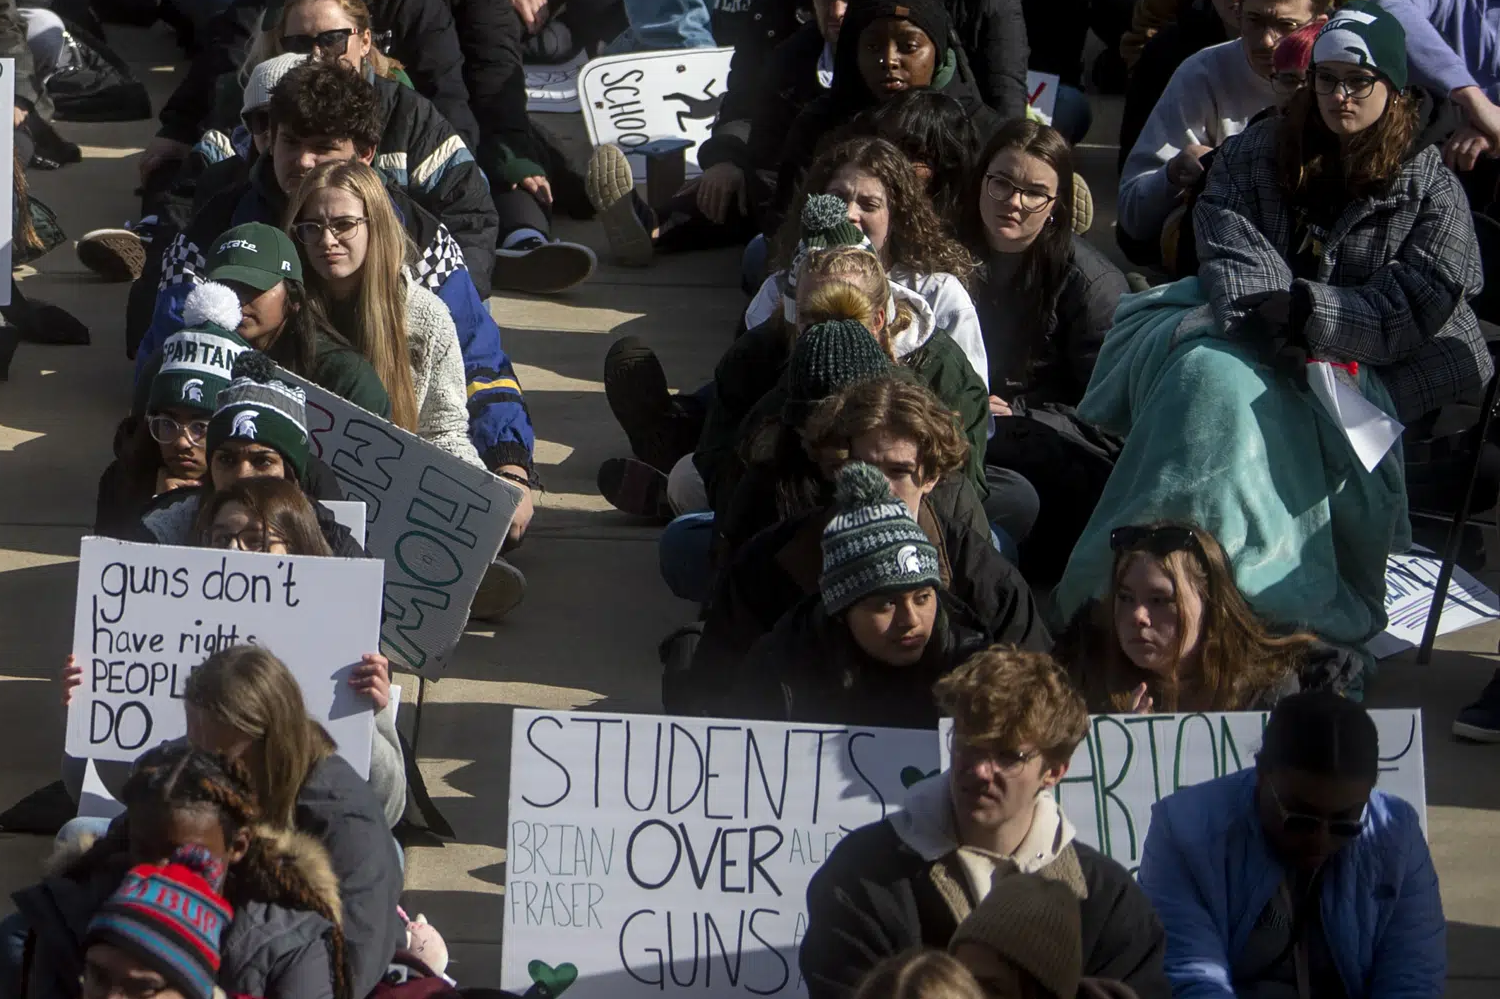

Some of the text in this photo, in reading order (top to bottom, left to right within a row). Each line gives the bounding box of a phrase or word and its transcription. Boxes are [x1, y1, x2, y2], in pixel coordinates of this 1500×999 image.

[601, 69, 649, 147] SCHOO
[281, 260, 291, 271] R
[101, 557, 300, 623] guns don't
[92, 594, 164, 654] have
[92, 658, 198, 699] PEOPL
[89, 700, 153, 750] DO
[522, 716, 887, 828] STUDENTS
[512, 820, 616, 877] BRIAN
[626, 819, 784, 896] OVER
[510, 881, 604, 928] FRASER
[619, 909, 790, 995] GUNS
